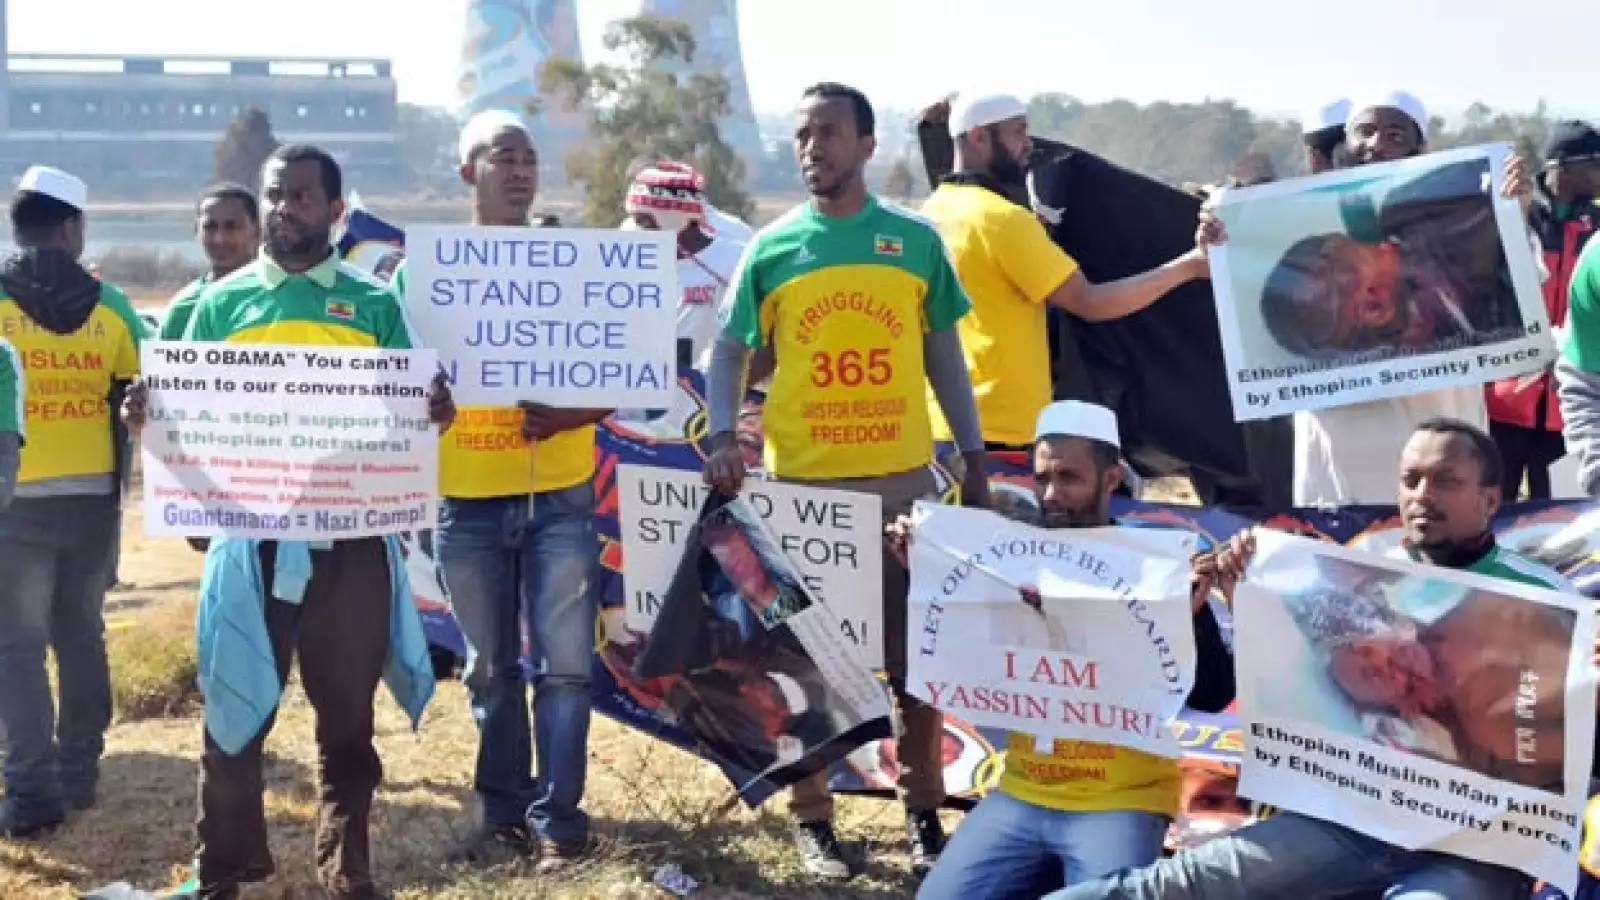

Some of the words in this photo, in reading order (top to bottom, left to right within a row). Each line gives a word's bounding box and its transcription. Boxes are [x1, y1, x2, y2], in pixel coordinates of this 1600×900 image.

[435, 238, 578, 268] UNITED
[599, 243, 658, 270] WE
[430, 279, 561, 308] STAND
[584, 281, 661, 309] FOR
[796, 291, 904, 344] STRUGGLING
[465, 320, 627, 349] JUSTICE
[21, 348, 104, 370] ISLAM
[154, 348, 198, 365] "NO
[205, 348, 296, 368] OBAMA"
[304, 351, 342, 369] You
[437, 359, 458, 386] N
[480, 360, 669, 390] ETHIOPIA!
[811, 348, 893, 388] 365
[147, 374, 206, 390] listen
[215, 377, 236, 391] to
[243, 381, 277, 392] our
[284, 380, 428, 398] conversation.
[1246, 390, 1271, 407] by
[1378, 359, 1470, 386] Security
[1476, 347, 1541, 369] Force
[298, 412, 430, 433] supporting
[812, 423, 900, 445] FREEDOM!
[166, 430, 283, 449] Ethiopian
[163, 503, 290, 531] Guantanamo
[296, 513, 308, 528] =
[314, 510, 357, 531] Nazi
[792, 497, 854, 530] WE
[781, 534, 858, 569] FOR
[989, 539, 1073, 562] VOICE
[1077, 550, 1109, 578] BE
[1004, 650, 1017, 680] I
[1029, 654, 1100, 690] AM
[924, 680, 1049, 719] YASSIN
[1256, 746, 1280, 768] by
[1391, 788, 1493, 833] Security
[1502, 818, 1572, 853] Force
[1358, 751, 1441, 790] Muslim
[1448, 778, 1498, 808] Man
[1507, 797, 1578, 829] killed
